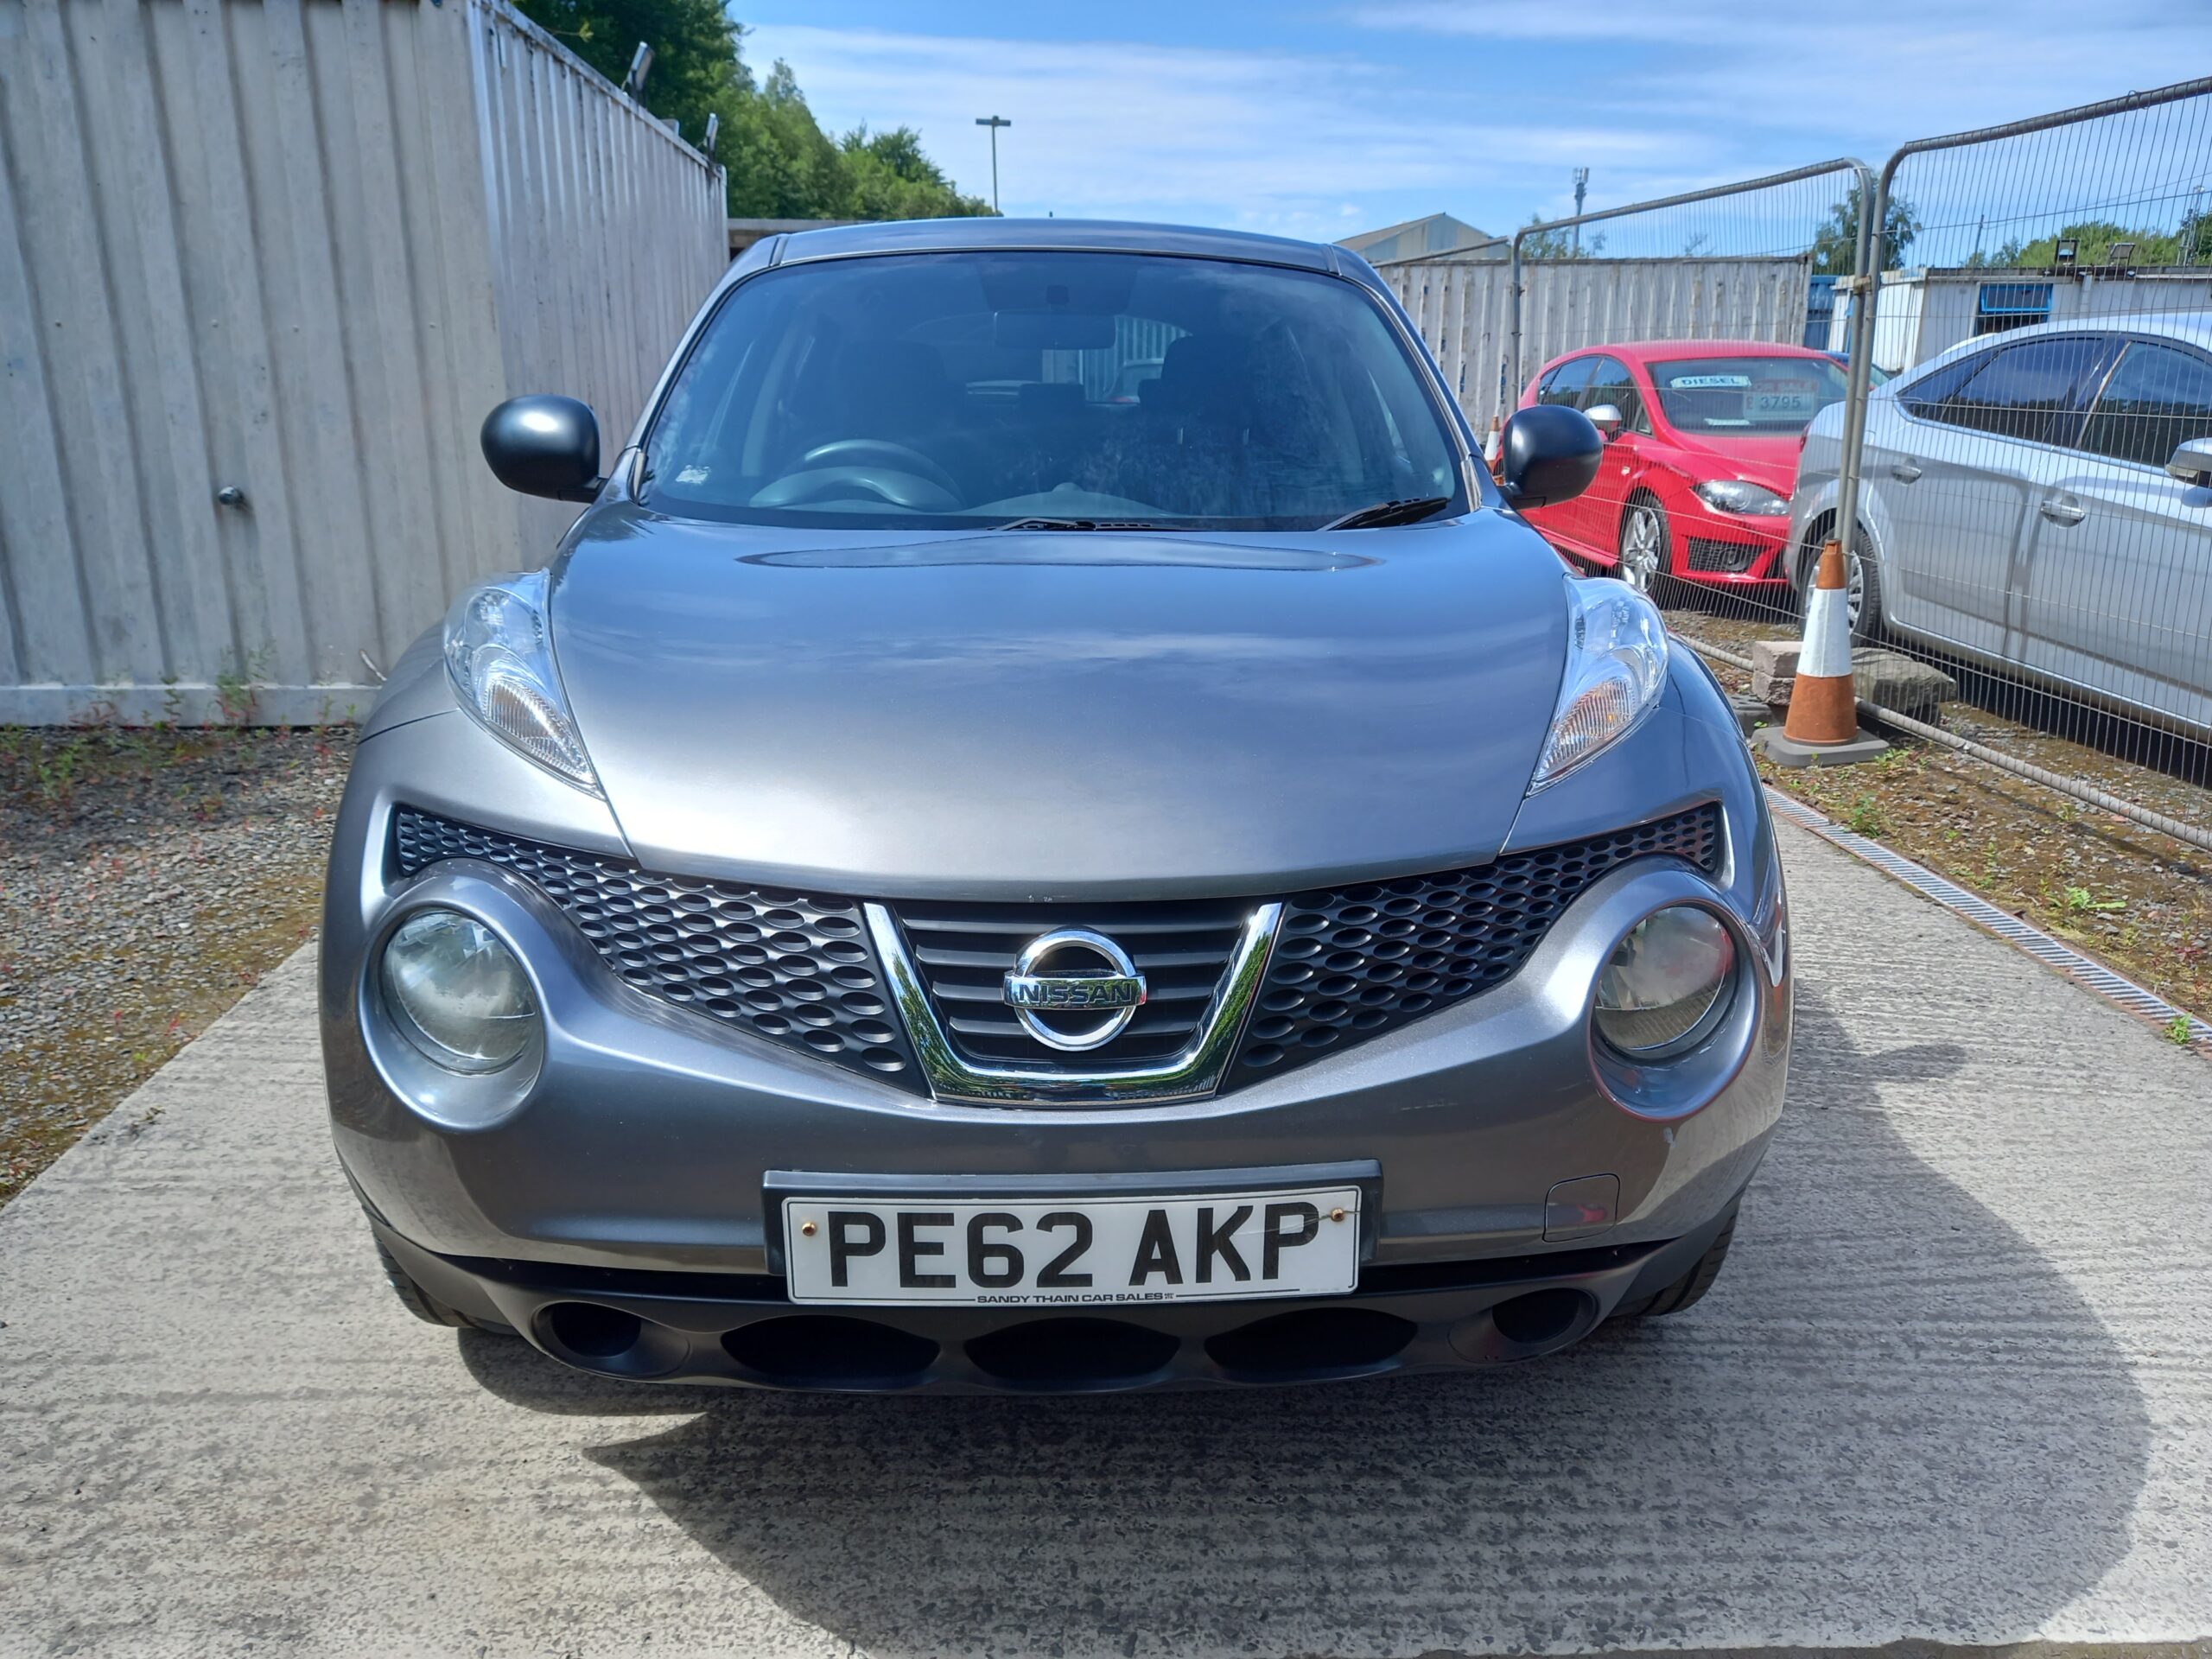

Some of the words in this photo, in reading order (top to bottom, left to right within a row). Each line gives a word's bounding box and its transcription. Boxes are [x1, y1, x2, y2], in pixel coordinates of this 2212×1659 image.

[1681, 378, 1740, 386] DIESEL
[1760, 396, 1802, 410] 3795
[1018, 983, 1132, 1003] NISSAN
[827, 1210, 1094, 1289] PE62
[1128, 1200, 1321, 1287] AKP
[1081, 1294, 1114, 1302] CAR
[1116, 1293, 1164, 1301] SALES
